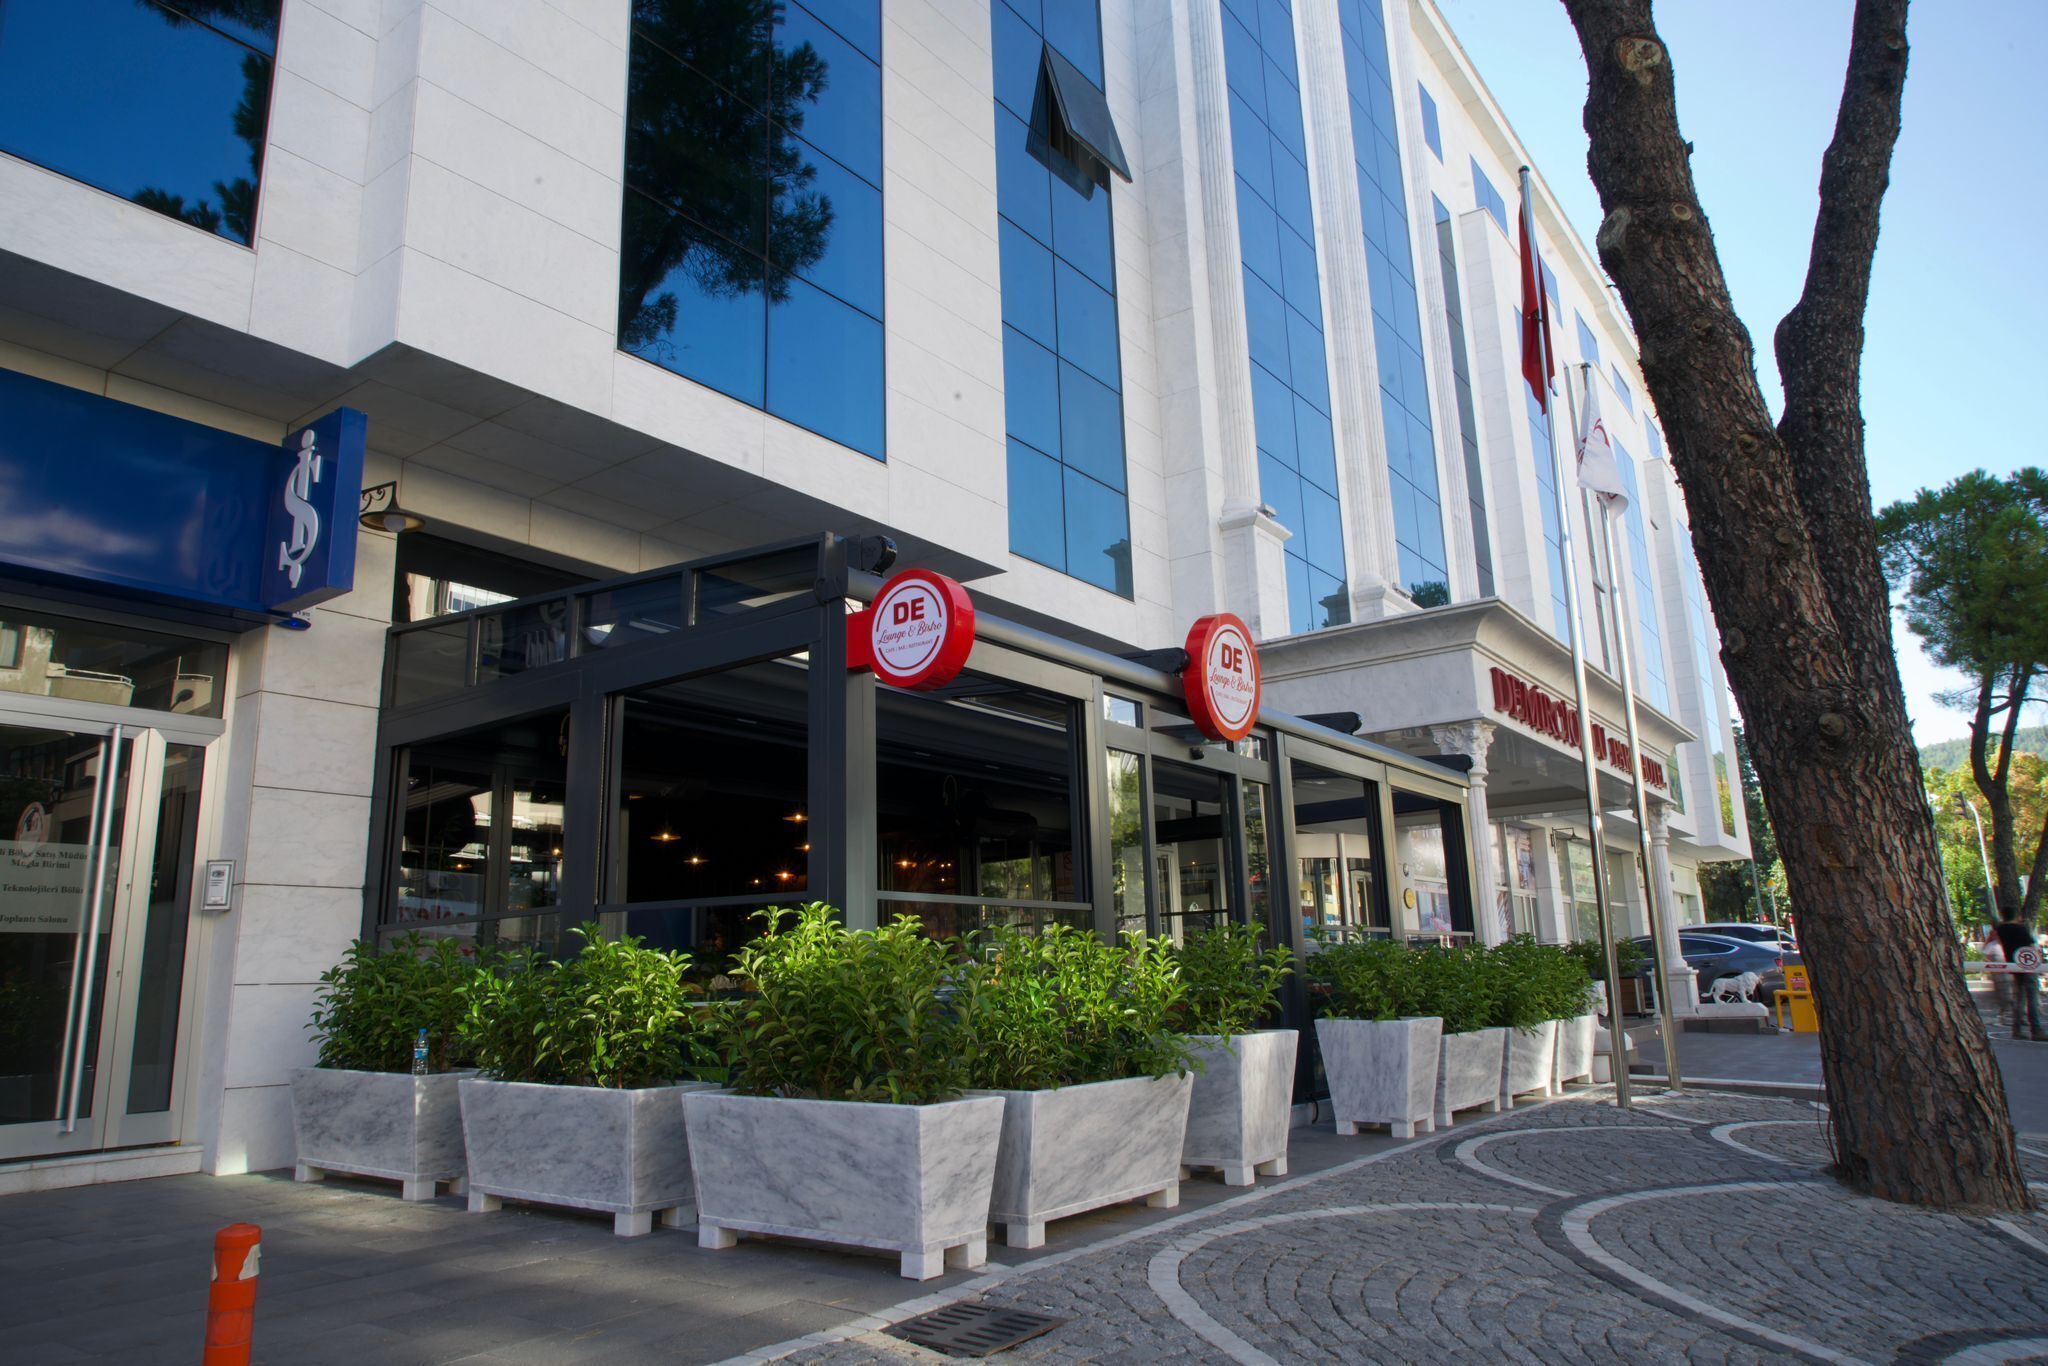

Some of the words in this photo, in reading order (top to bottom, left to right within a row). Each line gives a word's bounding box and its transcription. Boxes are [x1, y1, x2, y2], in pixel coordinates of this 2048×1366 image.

[893, 597, 925, 625] DE
[878, 629, 906, 644] Lounge
[908, 625, 916, 638] &
[916, 620, 942, 637] Bistro
[1221, 642, 1243, 674] DE
[42, 860, 71, 869] Birimi
[2, 883, 59, 895] Teknolojileri
